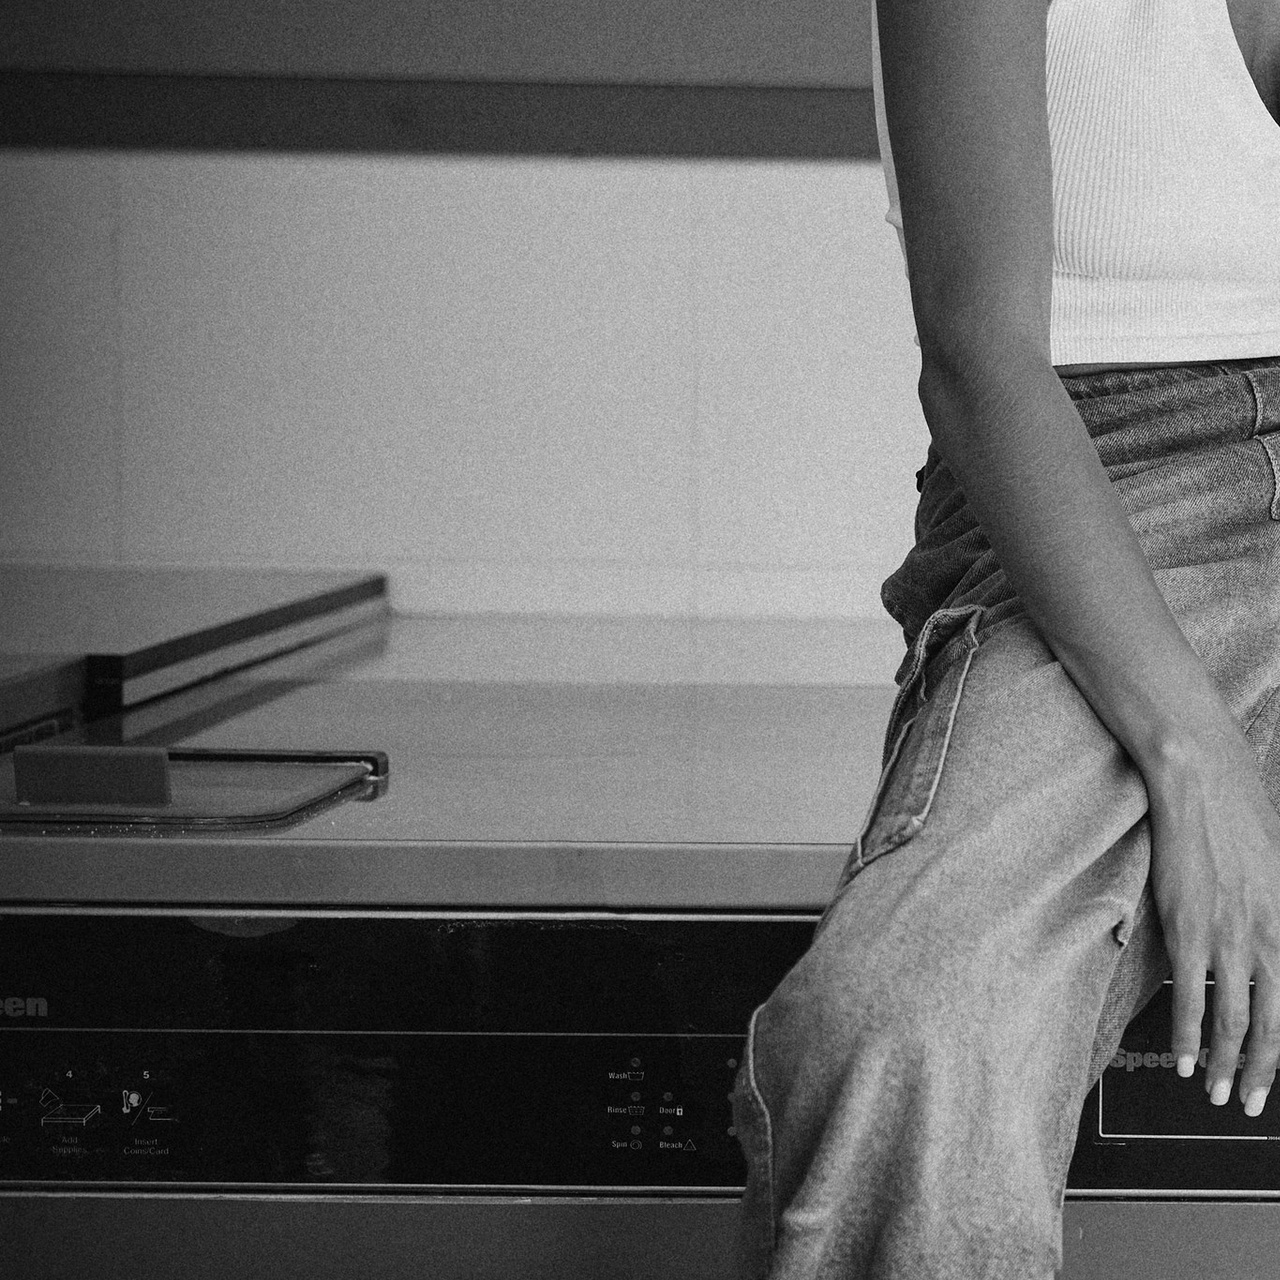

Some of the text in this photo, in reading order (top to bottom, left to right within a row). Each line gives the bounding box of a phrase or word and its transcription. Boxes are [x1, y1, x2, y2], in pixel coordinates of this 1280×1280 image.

[1110, 1049, 1178, 1072] Spee
[611, 1140, 627, 1148] Spin
[658, 1141, 683, 1149] Bleach
[123, 1147, 170, 1155] Coins/Card
